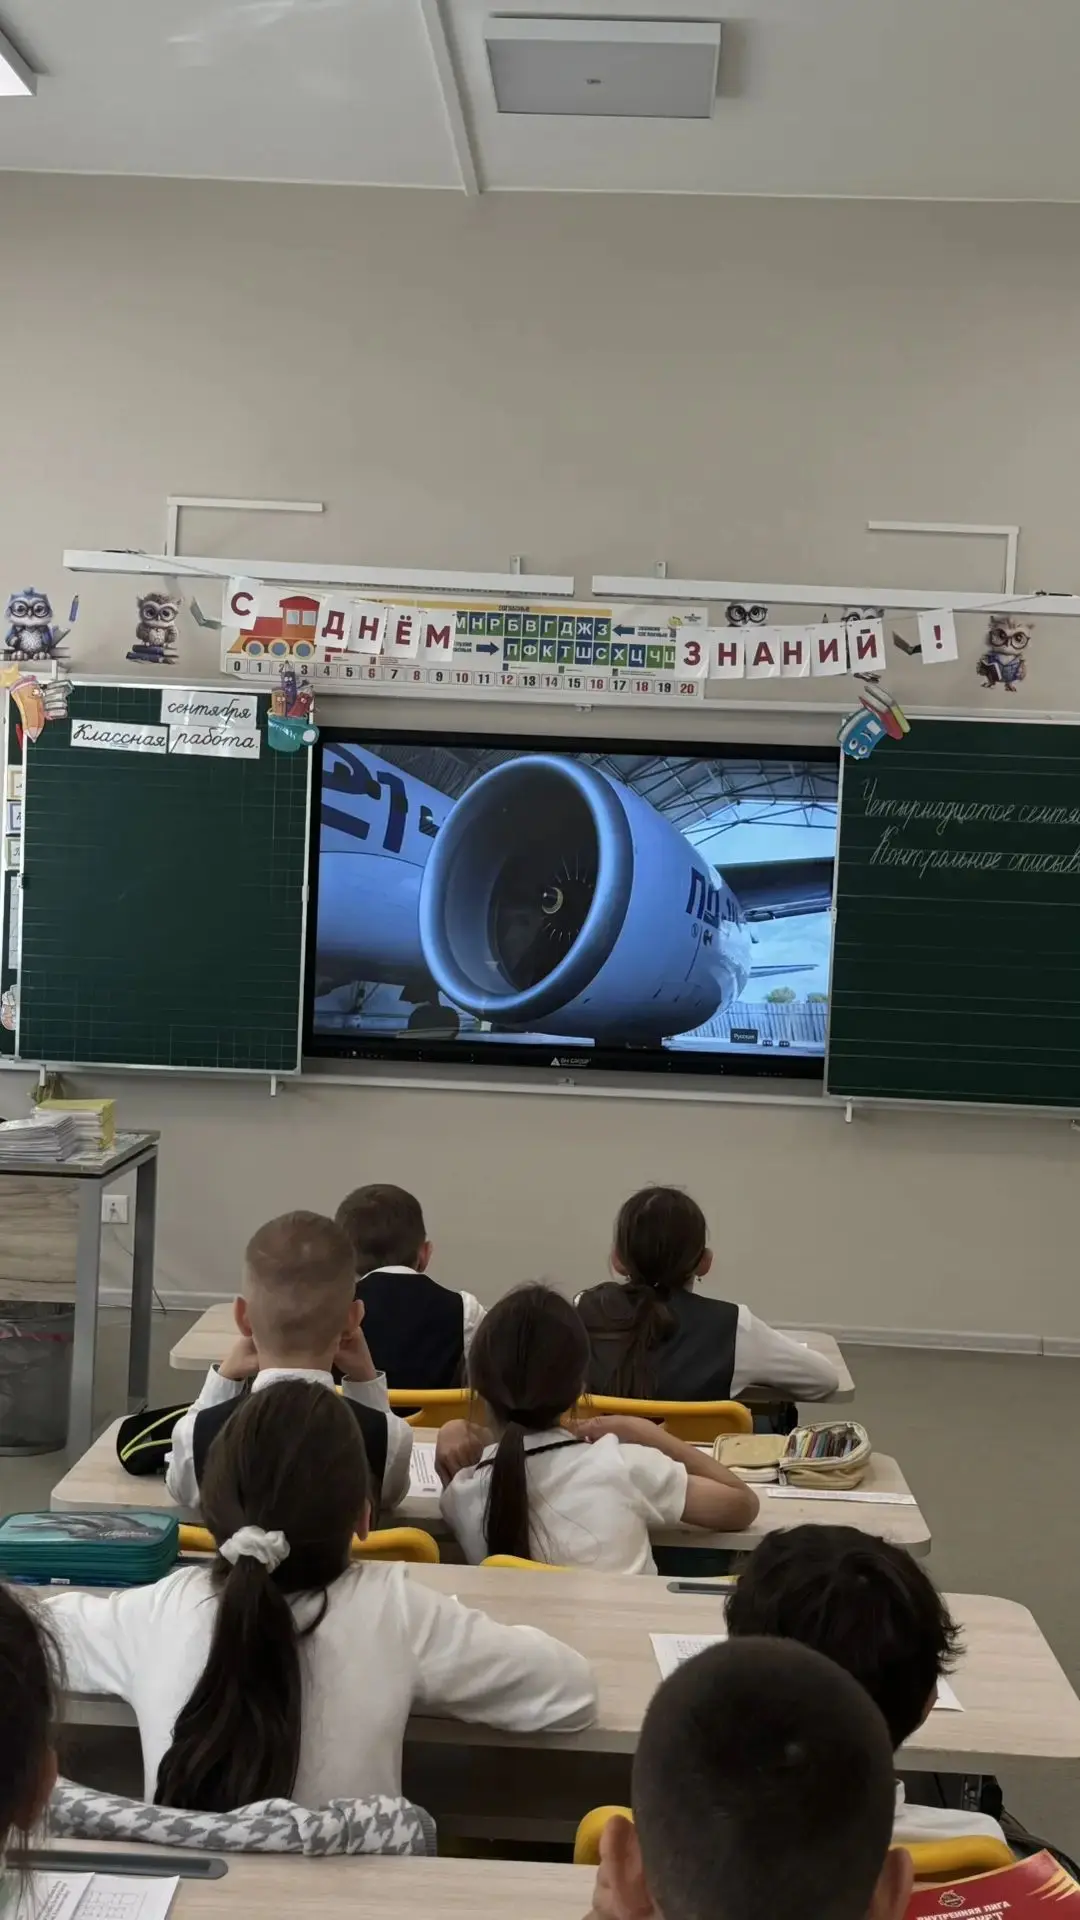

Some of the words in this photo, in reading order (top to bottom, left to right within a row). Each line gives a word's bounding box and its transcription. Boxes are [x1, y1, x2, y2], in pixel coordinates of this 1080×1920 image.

[231, 591, 254, 616] С
[321, 610, 451, 649] ДНЁМ
[684, 628, 877, 666] ЗНАНИЙ
[234, 661, 241, 671] 0
[257, 662, 262, 672] 1
[278, 663, 285, 674] 2
[301, 664, 308, 675] 3
[323, 666, 330, 676] 4
[346, 667, 353, 677] 5
[368, 668, 375, 678] 6
[391, 669, 398, 679] 7
[413, 670, 420, 680] 8
[436, 671, 443, 682] 9
[456, 672, 469, 683] 10
[479, 674, 490, 684] 11
[500, 675, 513, 685] 12
[523, 676, 536, 686] 13
[545, 677, 558, 687] 14
[568, 677, 580, 688] 15
[591, 679, 603, 689] 16
[614, 680, 626, 690] 17
[636, 681, 648, 691] 18
[658, 682, 671, 692] 19
[680, 683, 694, 694] 20
[167, 699, 252, 727] сентября
[73, 724, 166, 747] Классная
